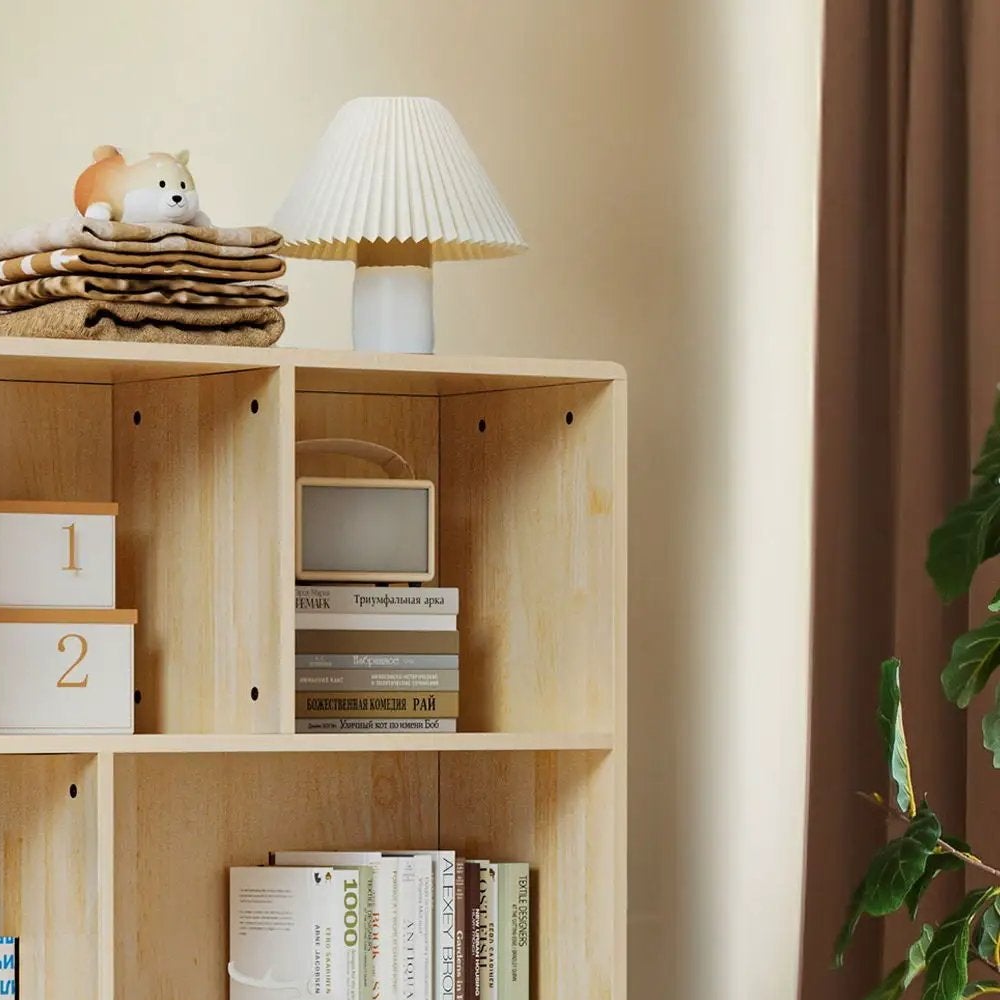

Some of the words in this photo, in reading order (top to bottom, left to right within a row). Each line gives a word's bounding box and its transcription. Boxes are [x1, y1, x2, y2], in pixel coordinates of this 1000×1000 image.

[61, 520, 83, 572] 1
[354, 594, 421, 608] Триумфальная
[424, 596, 445, 609] арка
[56, 633, 90, 688] 2
[306, 698, 368, 711] БОЖЕСТВЕННАЯ
[369, 698, 407, 711] КОМЕДИЯ
[412, 695, 436, 711] РАЙ
[424, 719, 440, 729] Боб
[442, 857, 454, 940] ALEXEY
[519, 875, 528, 905] TEXTILE
[343, 878, 358, 948] 1000
[519, 905, 528, 948] DESIGNERS
[456, 930, 464, 978] Gardens
[456, 980, 463, 992] in
